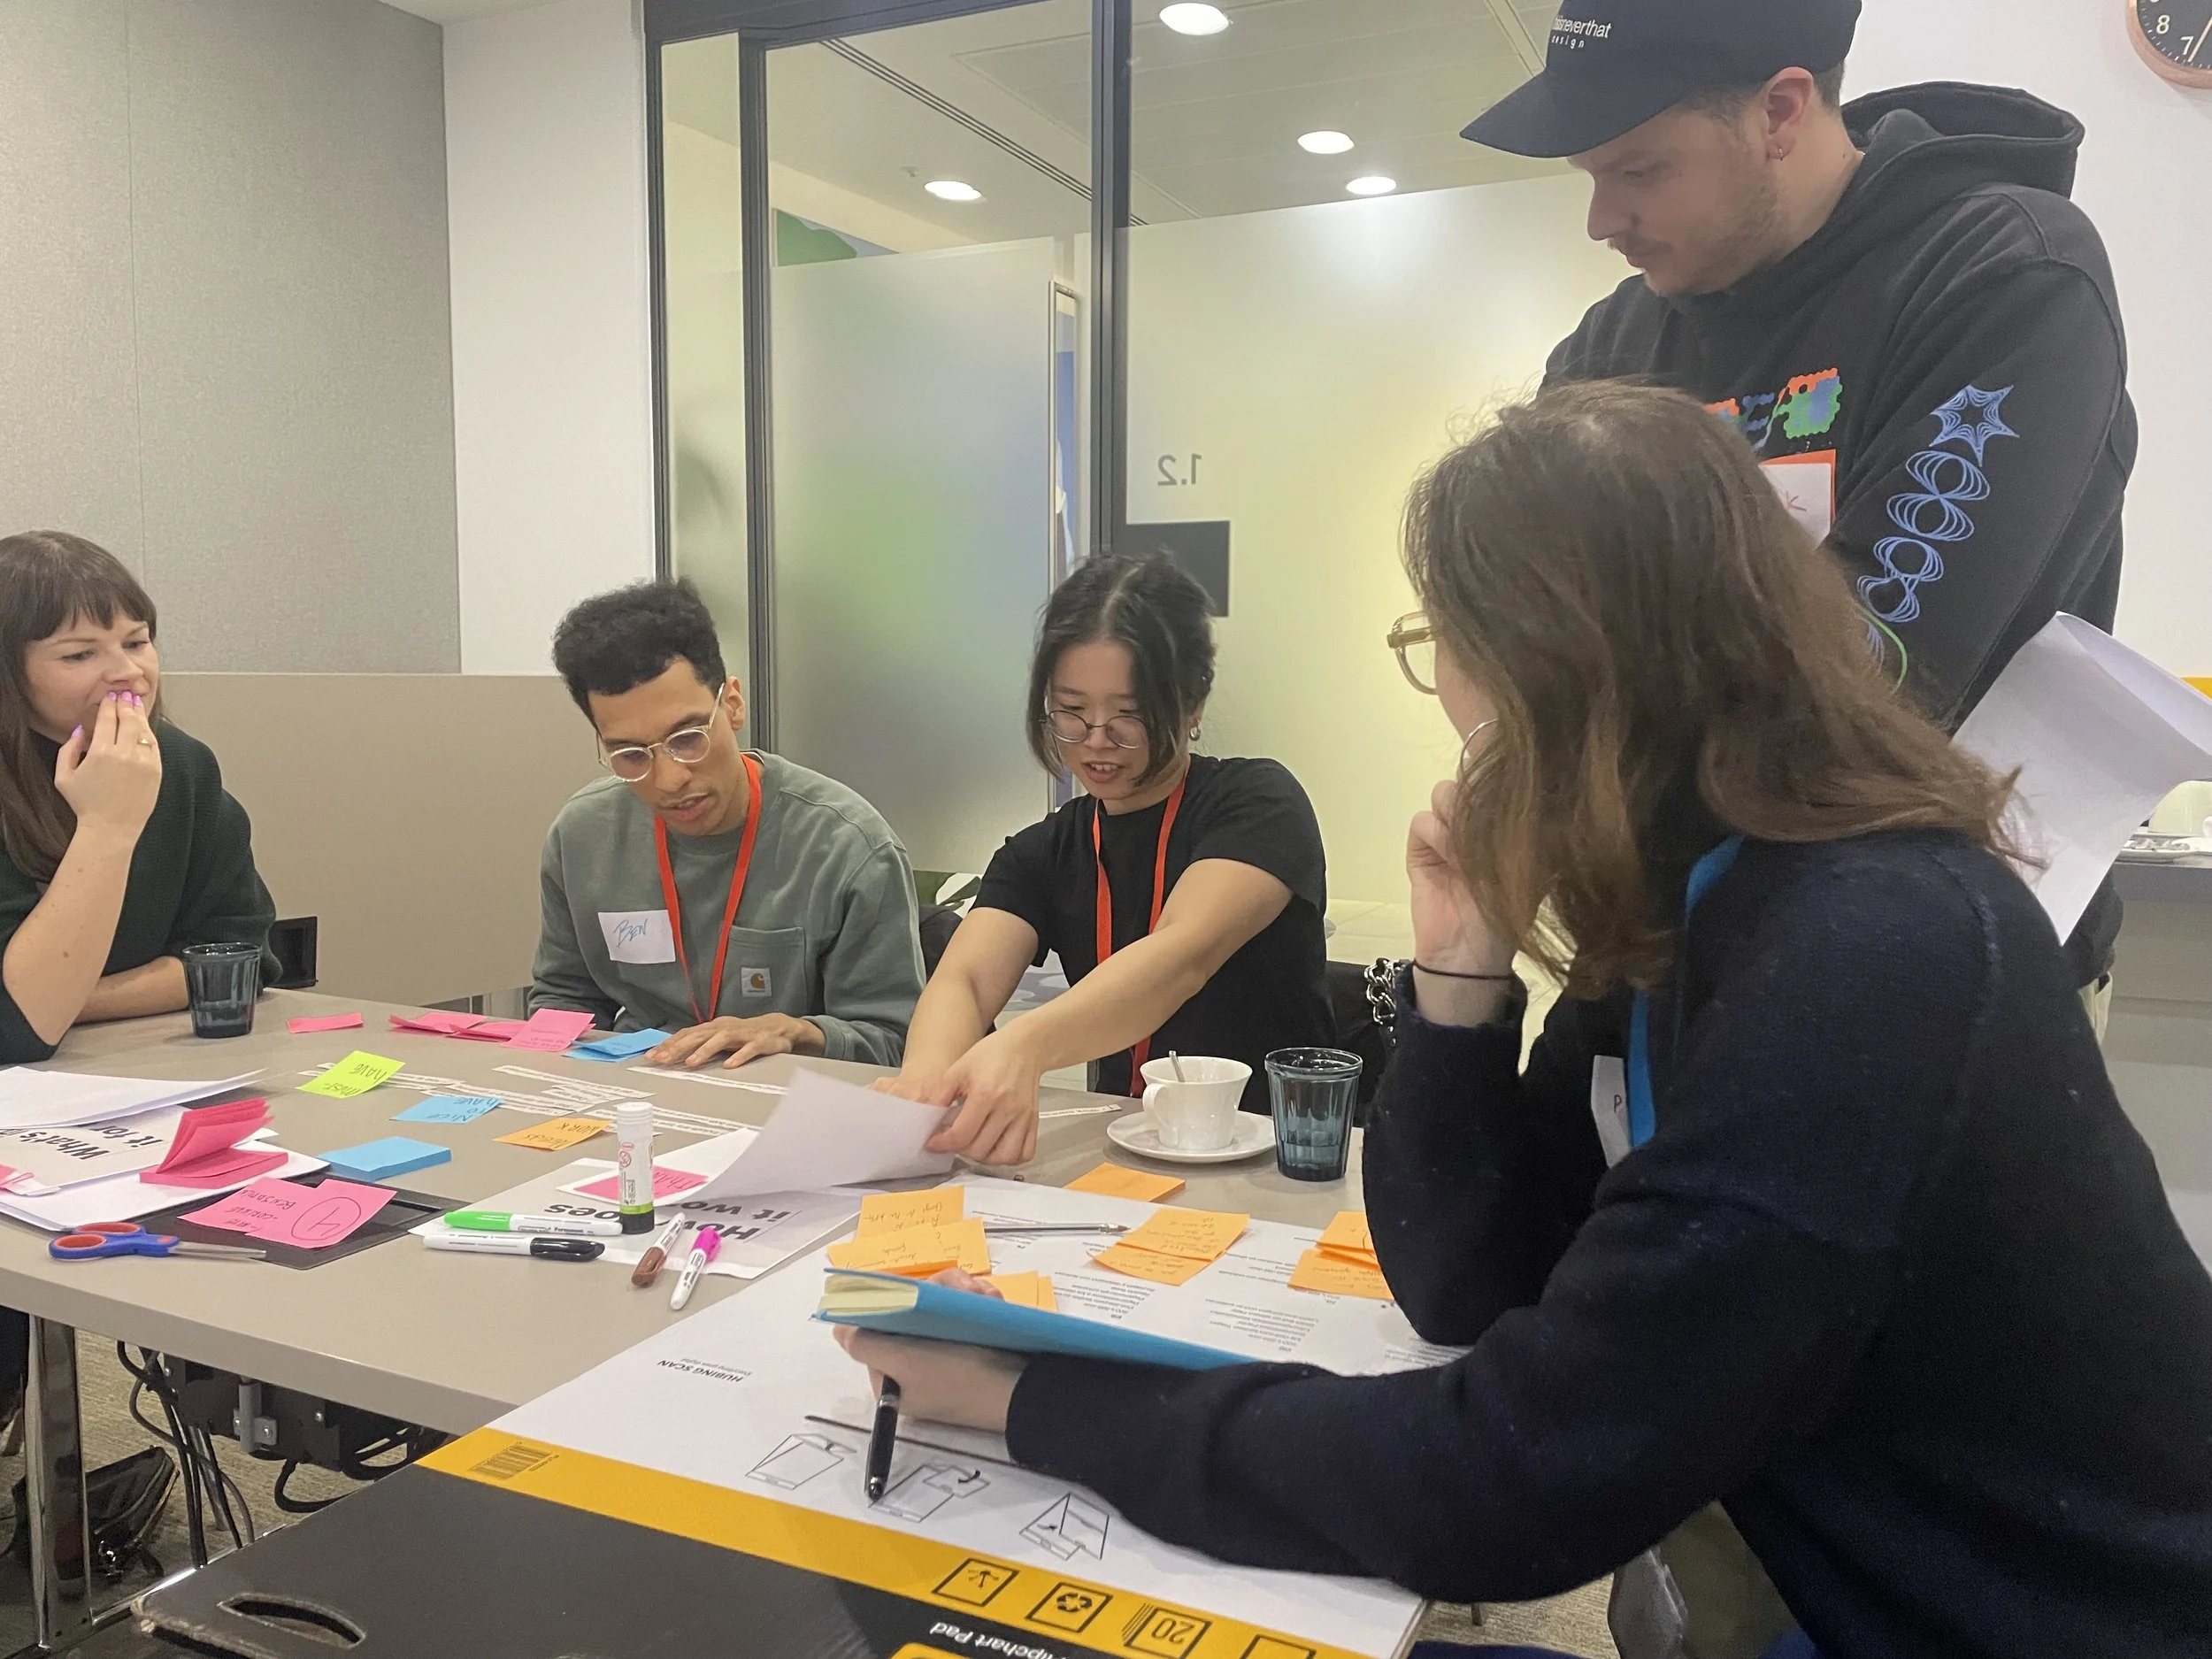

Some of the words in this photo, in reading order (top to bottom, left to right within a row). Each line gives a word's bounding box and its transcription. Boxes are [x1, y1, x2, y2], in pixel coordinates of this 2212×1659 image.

[2155, 14, 2170, 35] 8
[2179, 35, 2194, 56] 7
[89, 1125, 140, 1141] for
[127, 1136, 164, 1149] it
[19, 1131, 111, 1161] What's
[543, 1203, 619, 1224] oes
[664, 1201, 743, 1216] wo
[751, 1209, 791, 1223] it
[657, 1359, 695, 1372] SCAN
[929, 1621, 975, 1645] Pad
[1149, 1616, 1187, 1645] 20
[974, 1633, 1067, 1659] ipchart
